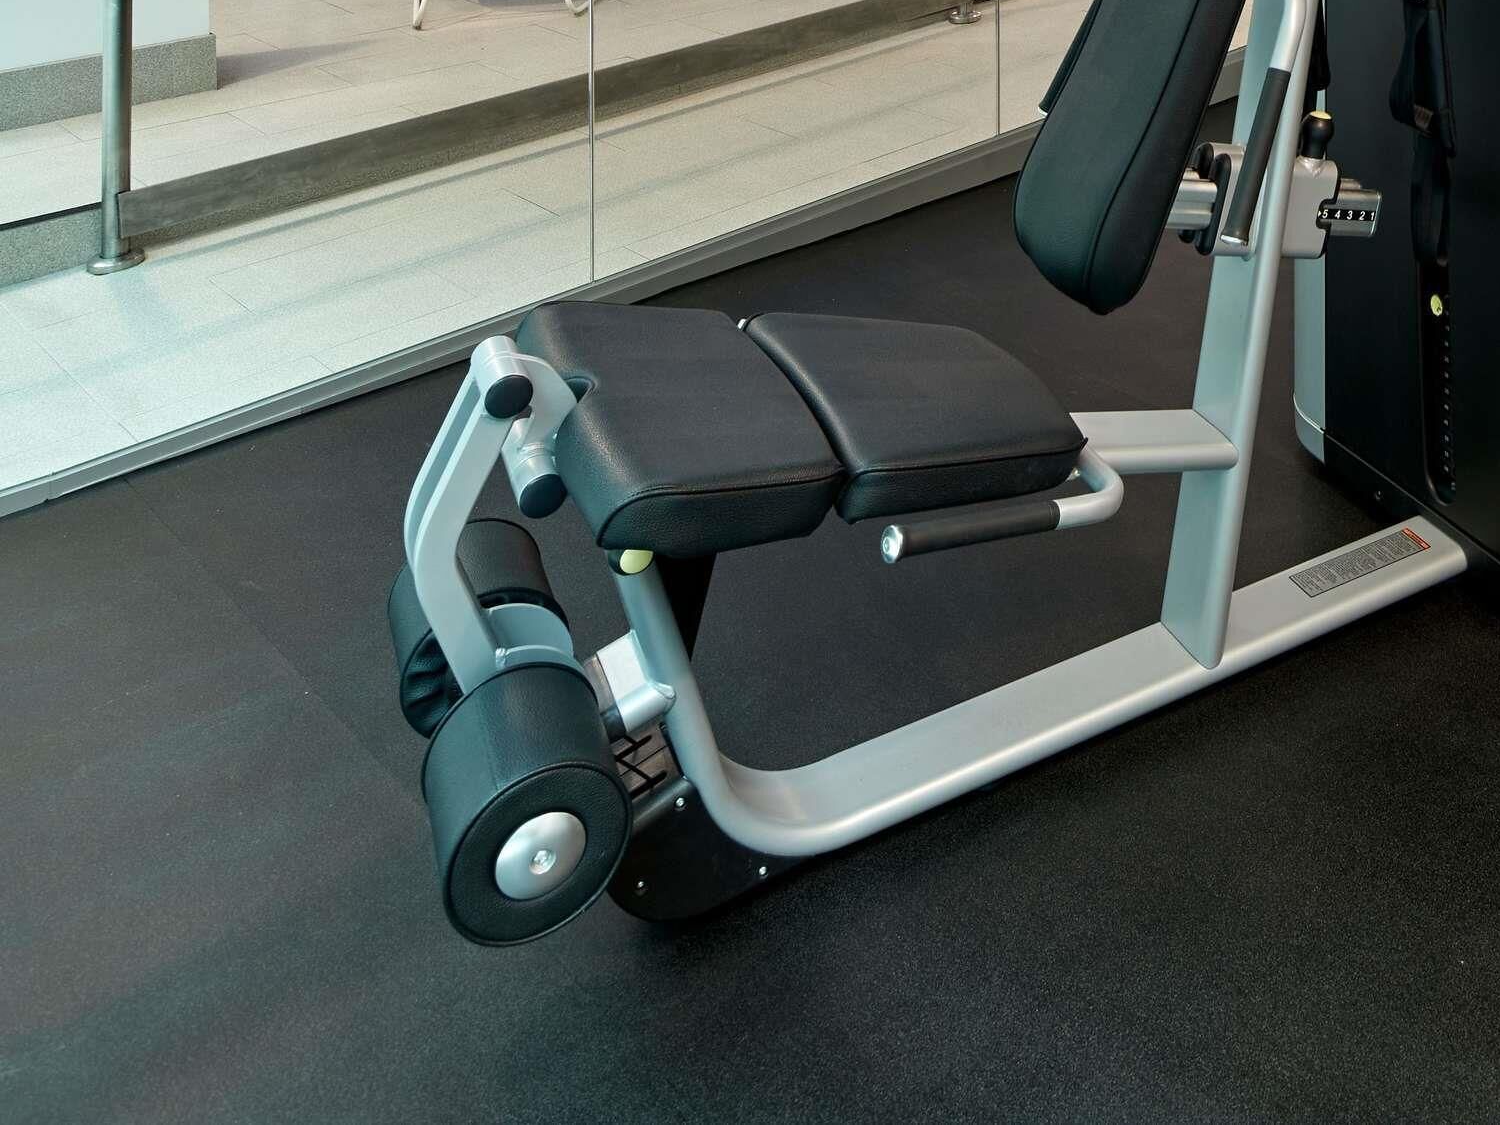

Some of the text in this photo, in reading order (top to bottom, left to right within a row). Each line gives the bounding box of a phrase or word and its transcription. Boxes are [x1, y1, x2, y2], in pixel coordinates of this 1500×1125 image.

[1322, 209, 1374, 221] 5 4 3 2 1
